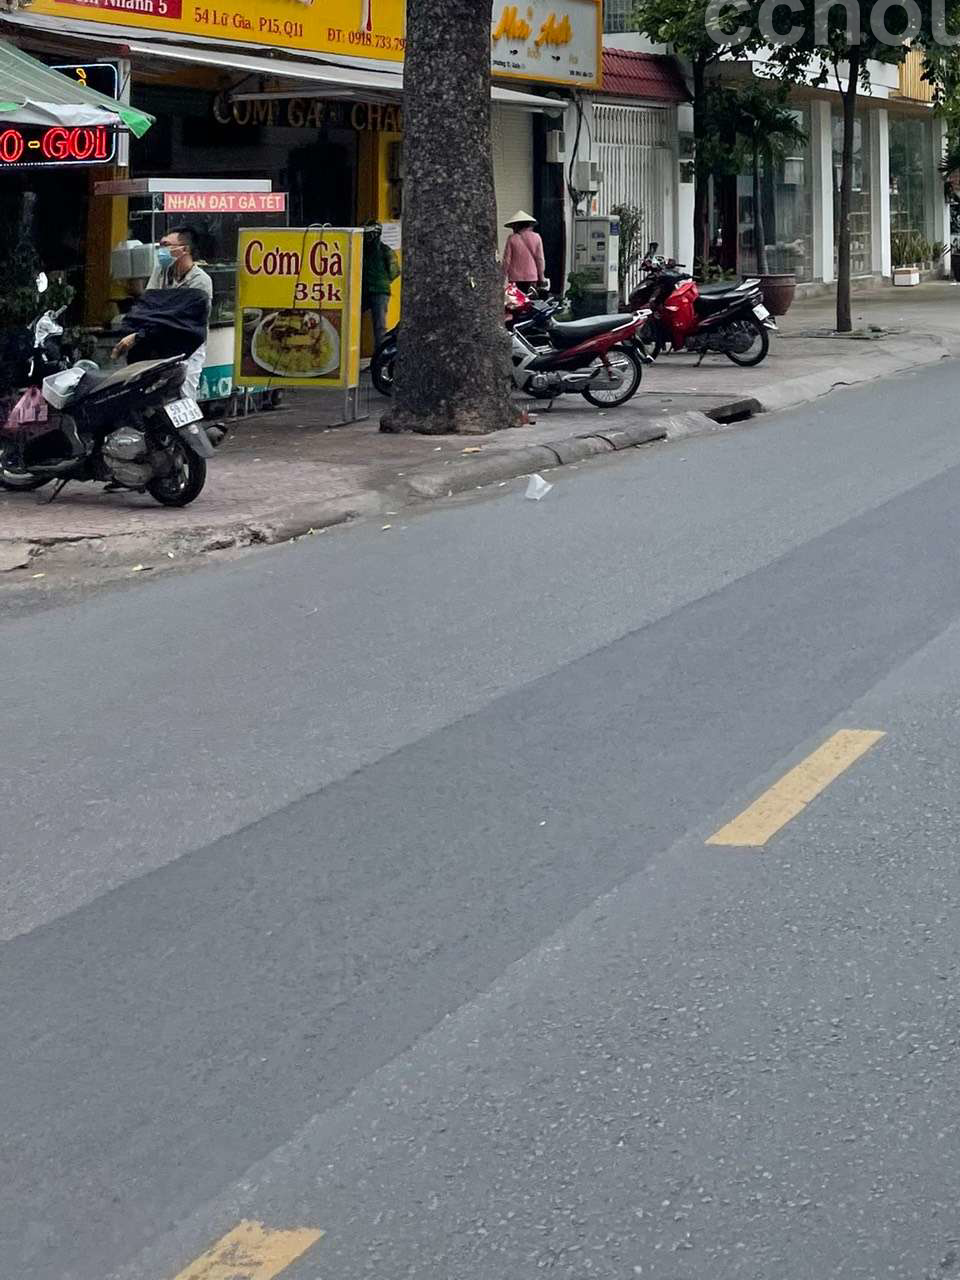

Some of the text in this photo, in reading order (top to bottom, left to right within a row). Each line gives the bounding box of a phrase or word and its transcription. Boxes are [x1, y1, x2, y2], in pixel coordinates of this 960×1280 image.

[194, 7, 208, 24] 54
[244, 239, 343, 277] Cơm Gà
[294, 282, 342, 302] 35k
